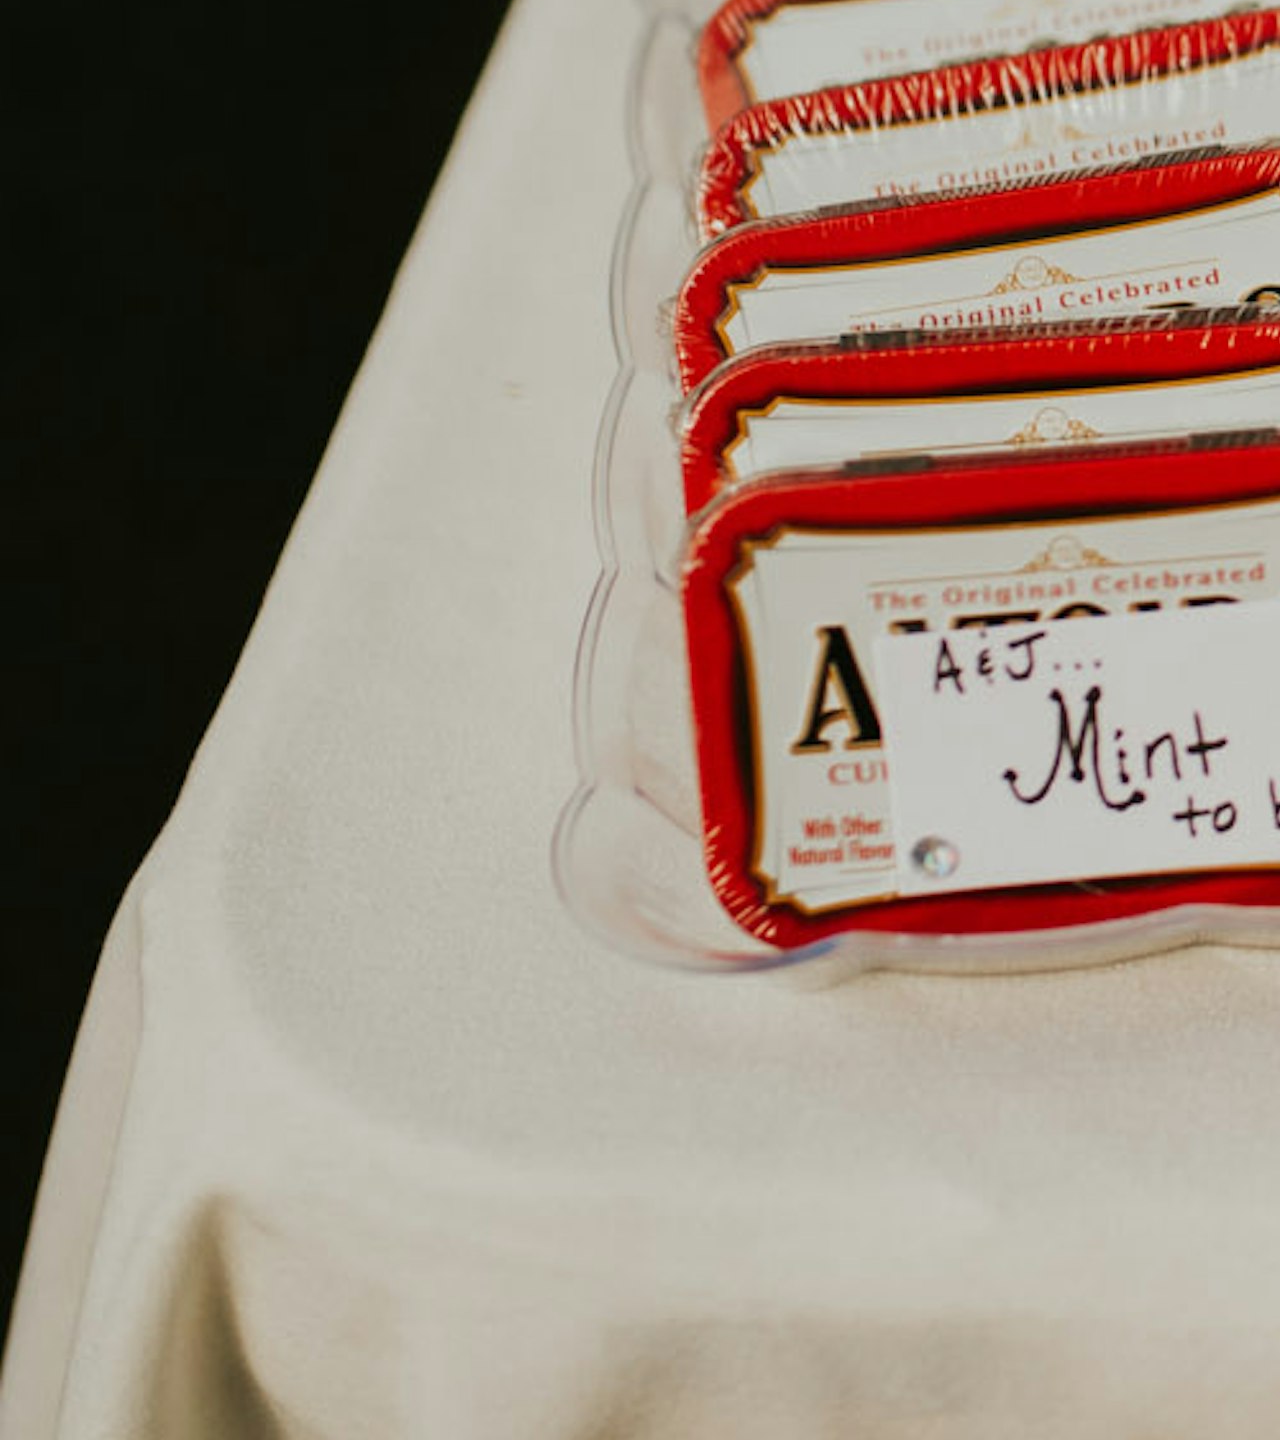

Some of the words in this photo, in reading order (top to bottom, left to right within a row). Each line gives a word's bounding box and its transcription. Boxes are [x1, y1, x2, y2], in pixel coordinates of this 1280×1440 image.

[1058, 268, 1221, 310] Celebrated
[868, 590, 928, 612] The
[941, 578, 1076, 607] Original
[1091, 563, 1267, 596] Celebrated
[1002, 684, 1228, 812] Mint
[1172, 792, 1238, 837] to
